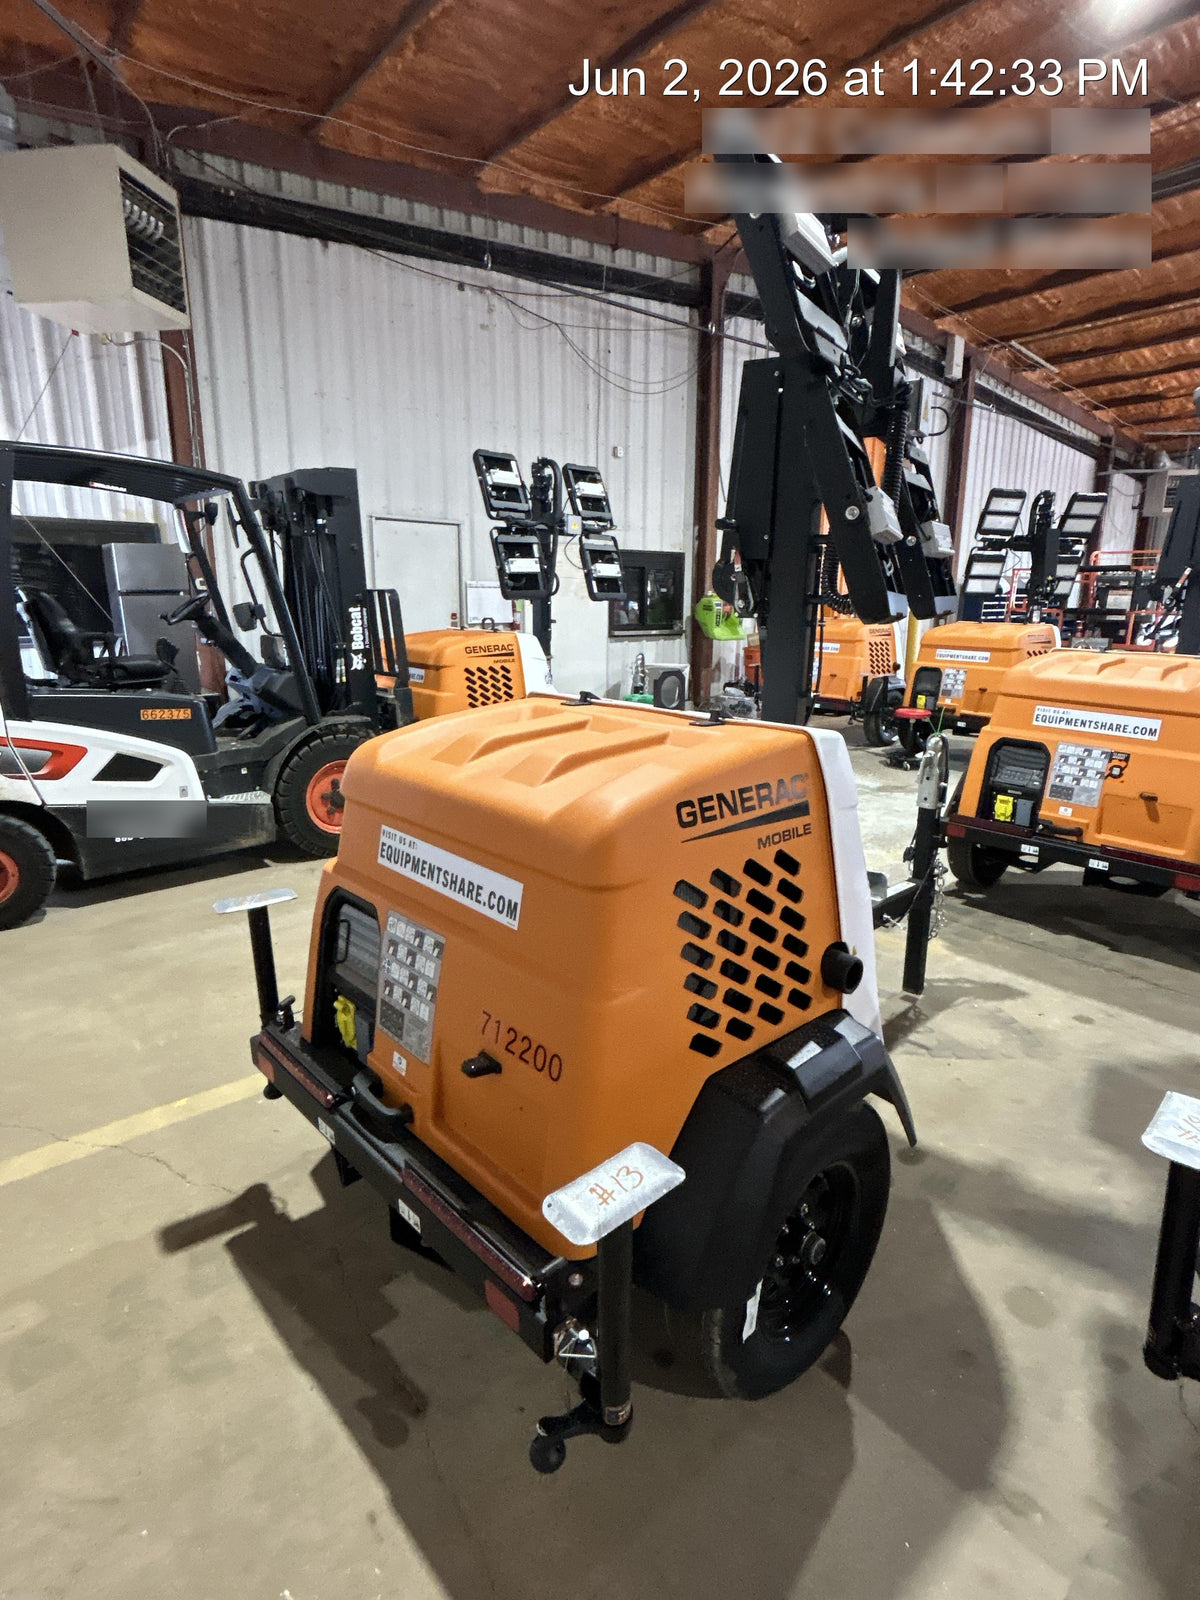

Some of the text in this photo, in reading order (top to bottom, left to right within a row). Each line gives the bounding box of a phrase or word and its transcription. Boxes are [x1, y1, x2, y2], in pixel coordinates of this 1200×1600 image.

[348, 606, 364, 650] Bobcat
[464, 643, 515, 655] GENERAC
[142, 709, 190, 719] 662375
[1035, 714, 1158, 737] EQUIPMENTSHARE.COM
[676, 773, 808, 829] GENERAC
[382, 828, 397, 841] VISIT
[399, 834, 406, 846] US
[757, 823, 812, 850] MOBILE
[380, 842, 519, 921] EQUIPMENTSHARE.COM
[482, 1010, 562, 1082] 712200
[589, 1166, 644, 1206] #13
